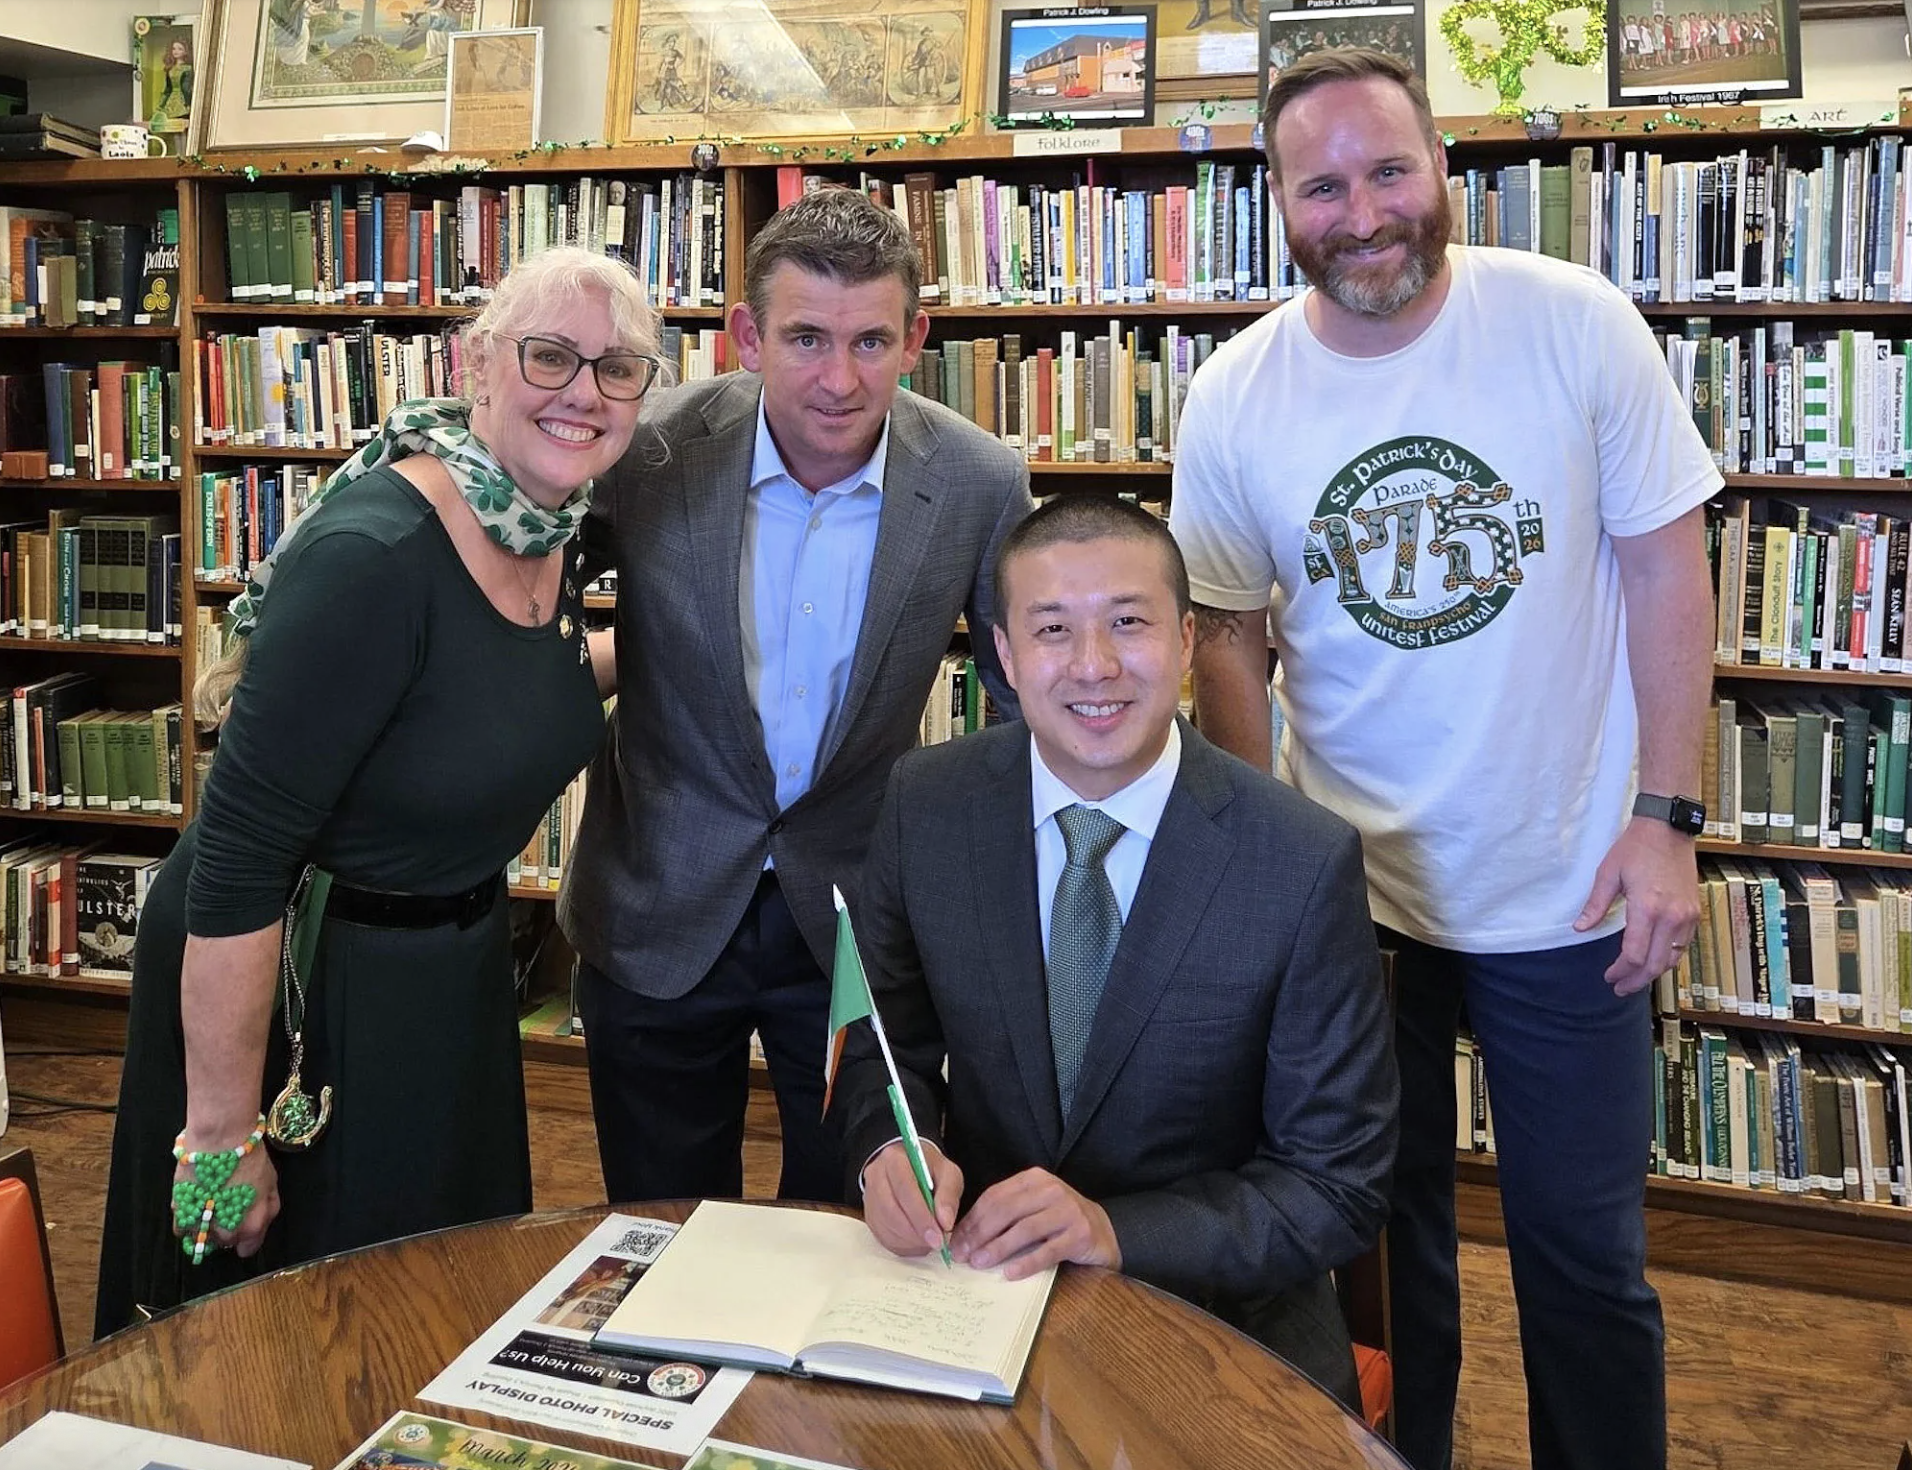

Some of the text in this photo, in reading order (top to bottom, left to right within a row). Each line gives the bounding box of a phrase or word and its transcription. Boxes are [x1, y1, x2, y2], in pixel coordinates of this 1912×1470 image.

[1042, 7, 1109, 17] Patrick J. Dowling
[1679, 92, 1715, 103] Festival
[1808, 109, 1847, 122] ART
[912, 191, 922, 225] FAMINE
[1636, 198, 1643, 207] OF
[323, 207, 332, 221] the
[322, 222, 332, 261] immigrant
[915, 230, 923, 242] IN
[381, 340, 391, 377] ULSTER
[396, 344, 404, 375] Children
[1894, 397, 1902, 418] Verse
[1893, 419, 1902, 435] and
[1892, 436, 1901, 455] Song
[1329, 441, 1479, 507] St. Patrick's Day
[1373, 478, 1437, 507] Parade
[1512, 498, 1541, 518] th
[1520, 522, 1541, 537] 20
[1729, 525, 1737, 541] THE
[1522, 538, 1542, 550] 26
[1729, 544, 1737, 563] GAA
[1896, 532, 1908, 571] RULE 42
[1772, 561, 1782, 583] Story
[1889, 559, 1897, 576] THAT
[604, 579, 612, 590] R
[1770, 585, 1781, 624] Clonduff
[1888, 588, 1901, 644] SEÁN KELLY
[1754, 898, 1764, 930] Patrick's
[1755, 931, 1765, 947] Day
[1757, 948, 1767, 966] with
[1782, 1064, 1790, 1075] The
[1786, 1117, 1794, 1140] William
[1684, 1130, 1692, 1154] IRELAND
[1787, 1141, 1795, 1159] Butler
[500, 1349, 529, 1362] Us?
[531, 1353, 570, 1370] Help
[572, 1362, 605, 1378] You
[608, 1367, 640, 1384] Can
[465, 1380, 538, 1402] DISPLAY
[539, 1396, 600, 1416] PHOTO
[603, 1405, 674, 1430] SPECIAL
[458, 1438, 527, 1468] March
